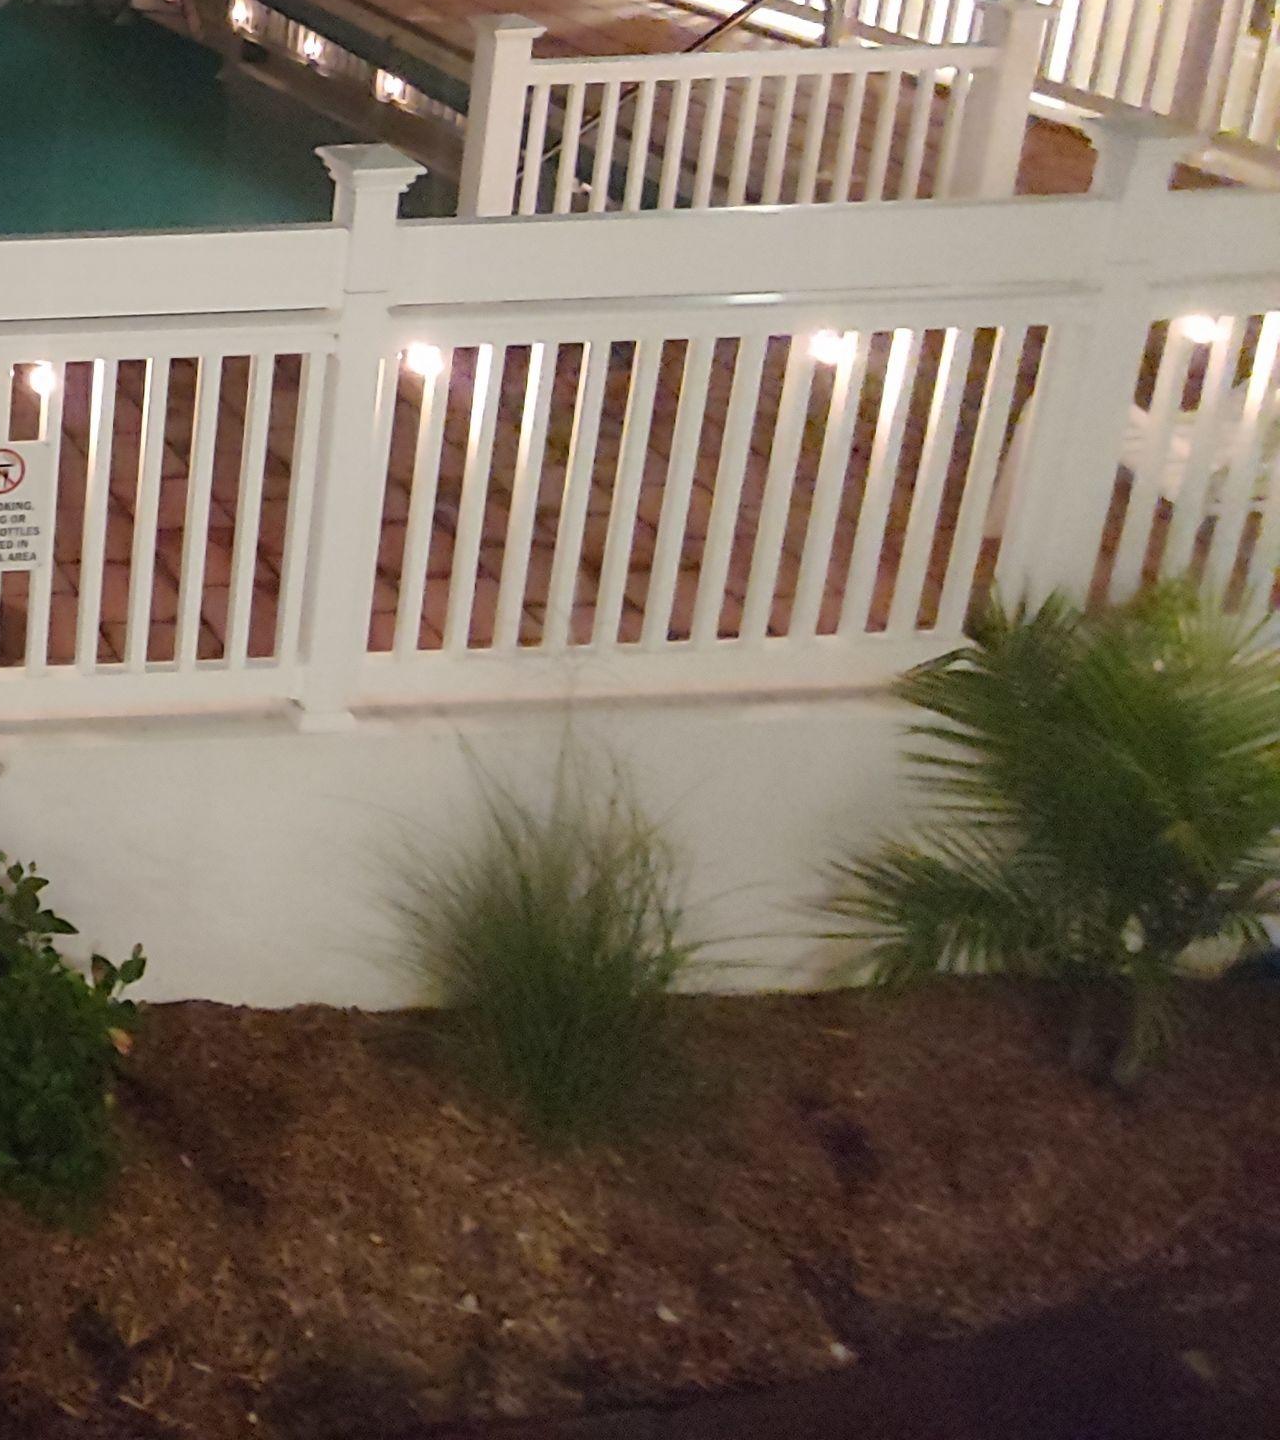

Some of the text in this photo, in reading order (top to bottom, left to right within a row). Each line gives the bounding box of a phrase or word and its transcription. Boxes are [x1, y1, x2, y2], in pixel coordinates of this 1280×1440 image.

[11, 514, 26, 523] OR
[17, 540, 28, 548] IN
[8, 552, 36, 561] AREA
